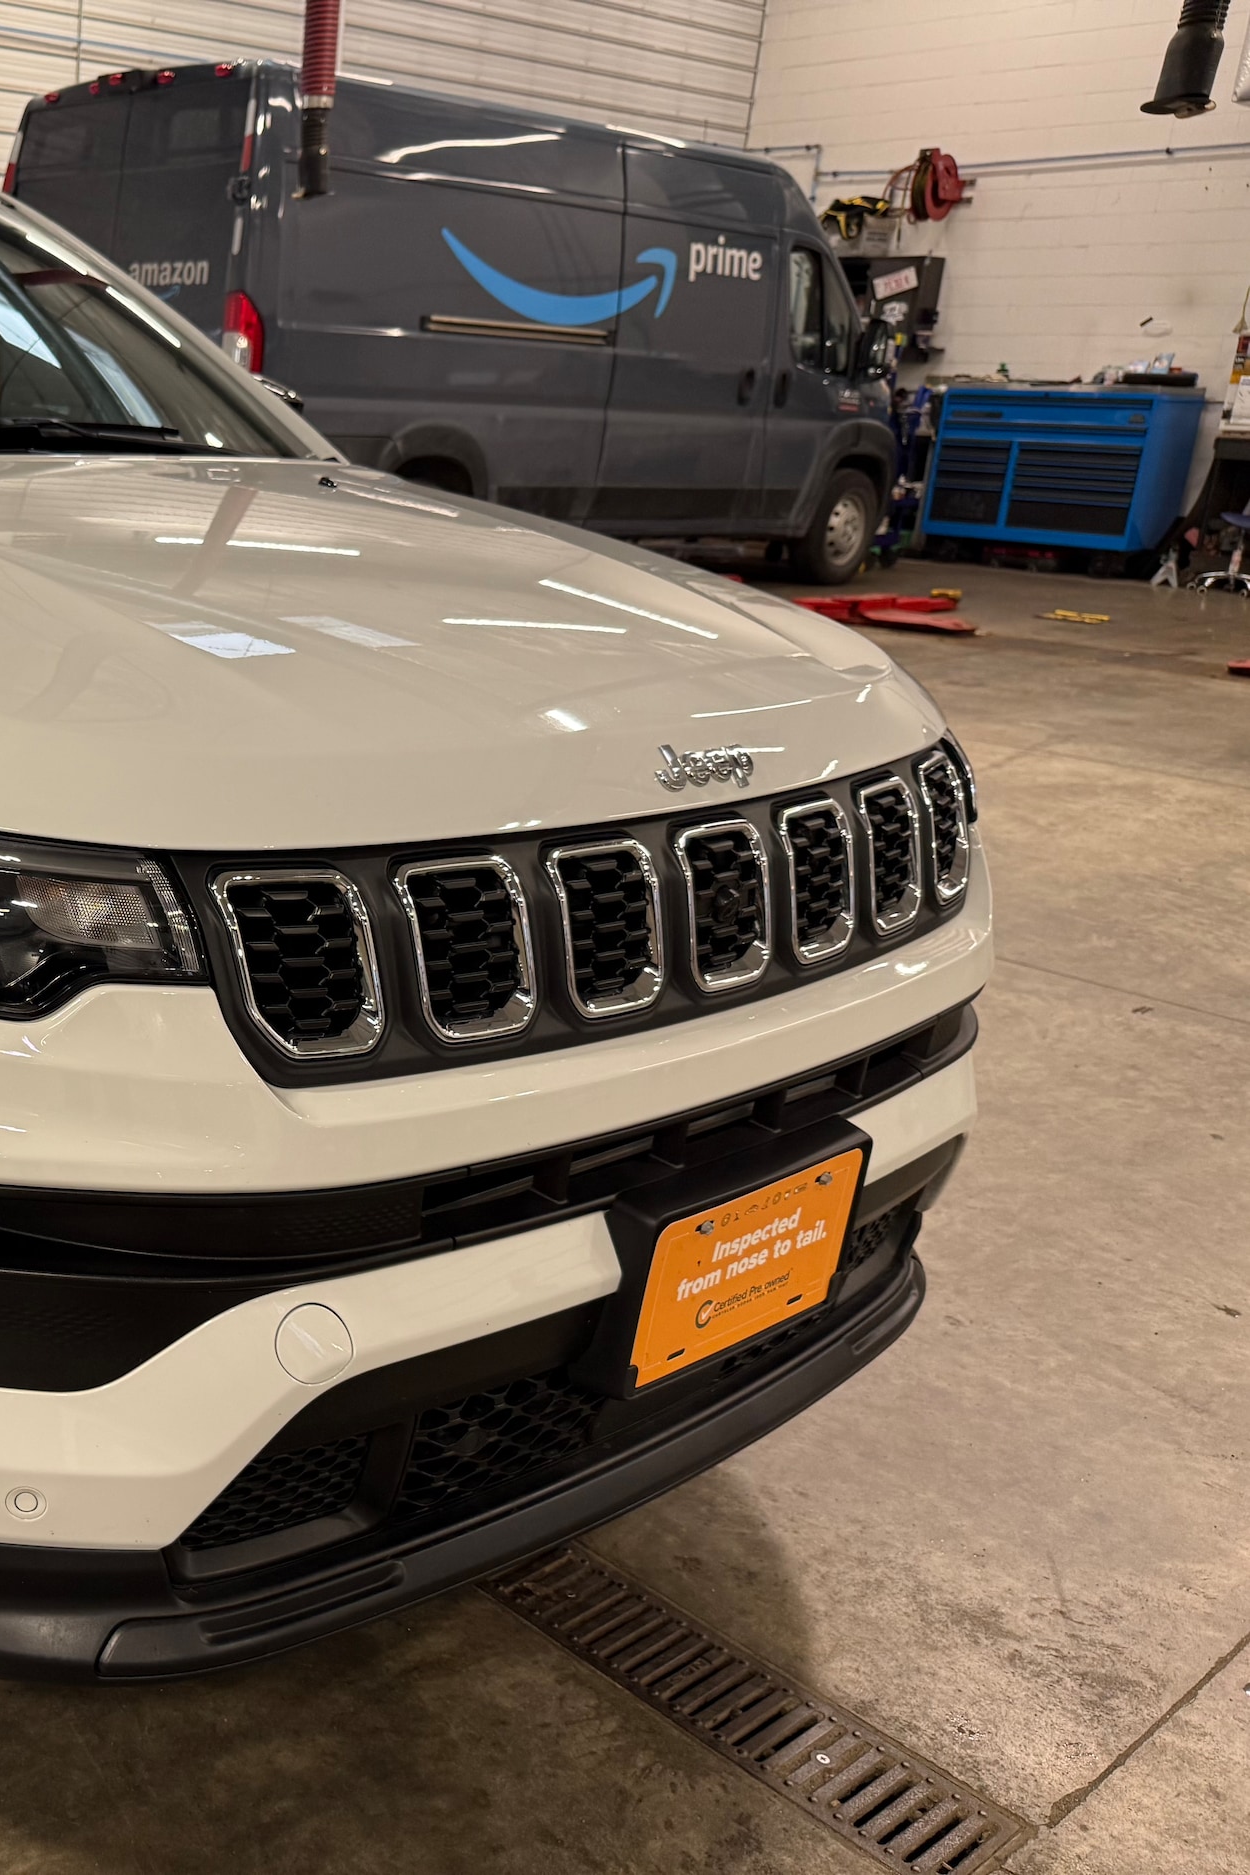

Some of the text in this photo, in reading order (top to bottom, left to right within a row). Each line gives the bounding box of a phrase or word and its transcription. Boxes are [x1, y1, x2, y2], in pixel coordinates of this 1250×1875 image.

[129, 261, 209, 286] amazon
[688, 234, 763, 282] prime
[654, 744, 754, 793] Jeep
[711, 1207, 802, 1263] Inspected
[676, 1219, 827, 1301] from nose to tail.
[713, 1289, 748, 1312] Certified
